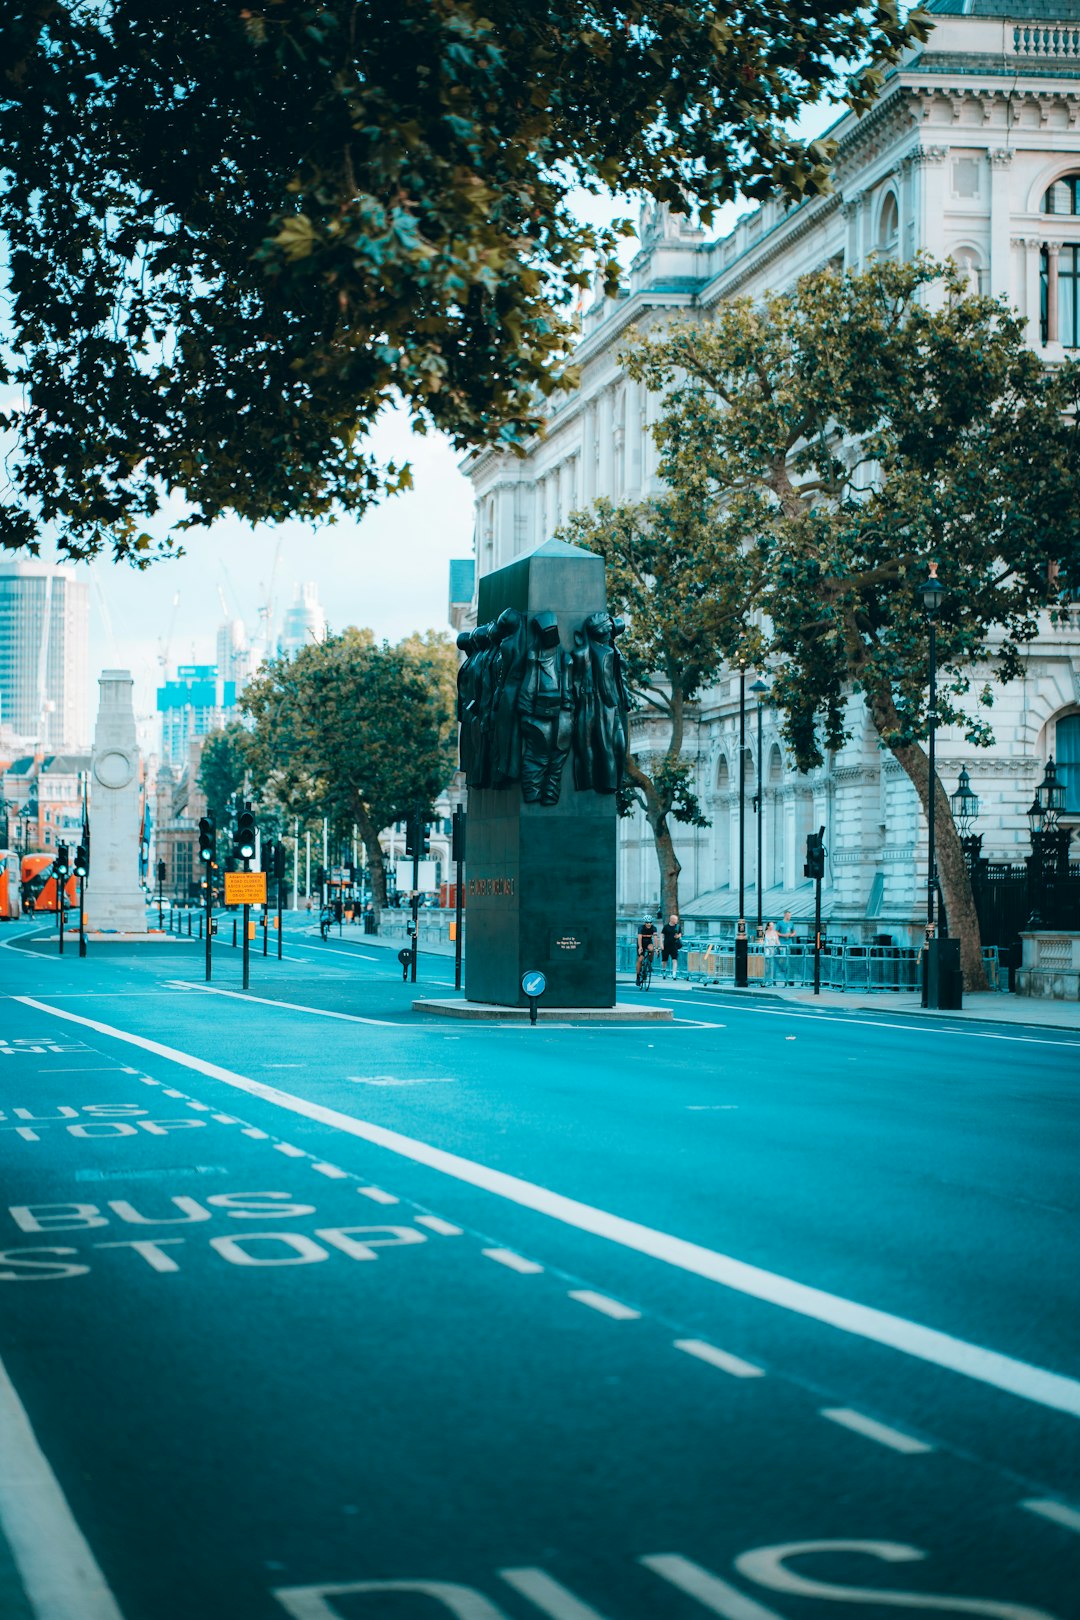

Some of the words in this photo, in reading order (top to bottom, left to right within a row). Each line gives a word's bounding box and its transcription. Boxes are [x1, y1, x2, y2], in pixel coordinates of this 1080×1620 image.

[0, 1044, 97, 1055] NE
[0, 1103, 149, 1121] US
[0, 1119, 206, 1141] TOP
[8, 1191, 316, 1233] BUS
[0, 1226, 428, 1281] STOP
